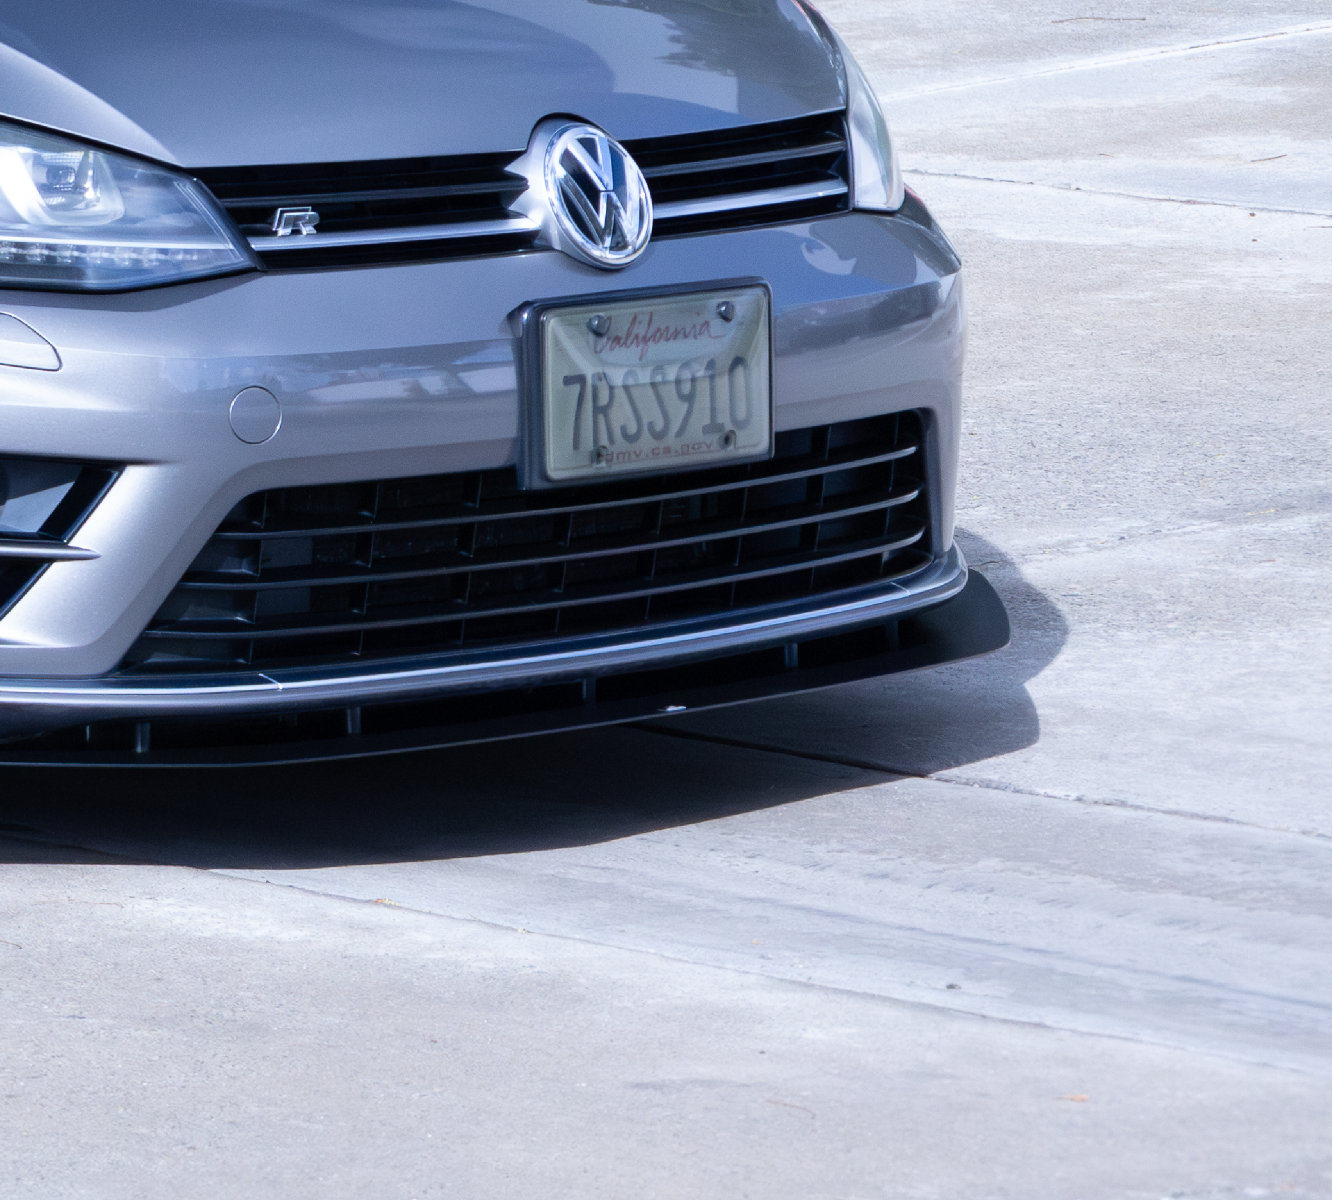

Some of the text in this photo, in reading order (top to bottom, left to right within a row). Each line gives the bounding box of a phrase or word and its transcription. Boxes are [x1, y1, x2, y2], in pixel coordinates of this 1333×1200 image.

[272, 206, 320, 236] R
[592, 311, 725, 361] California
[562, 356, 752, 451] 7RSS910
